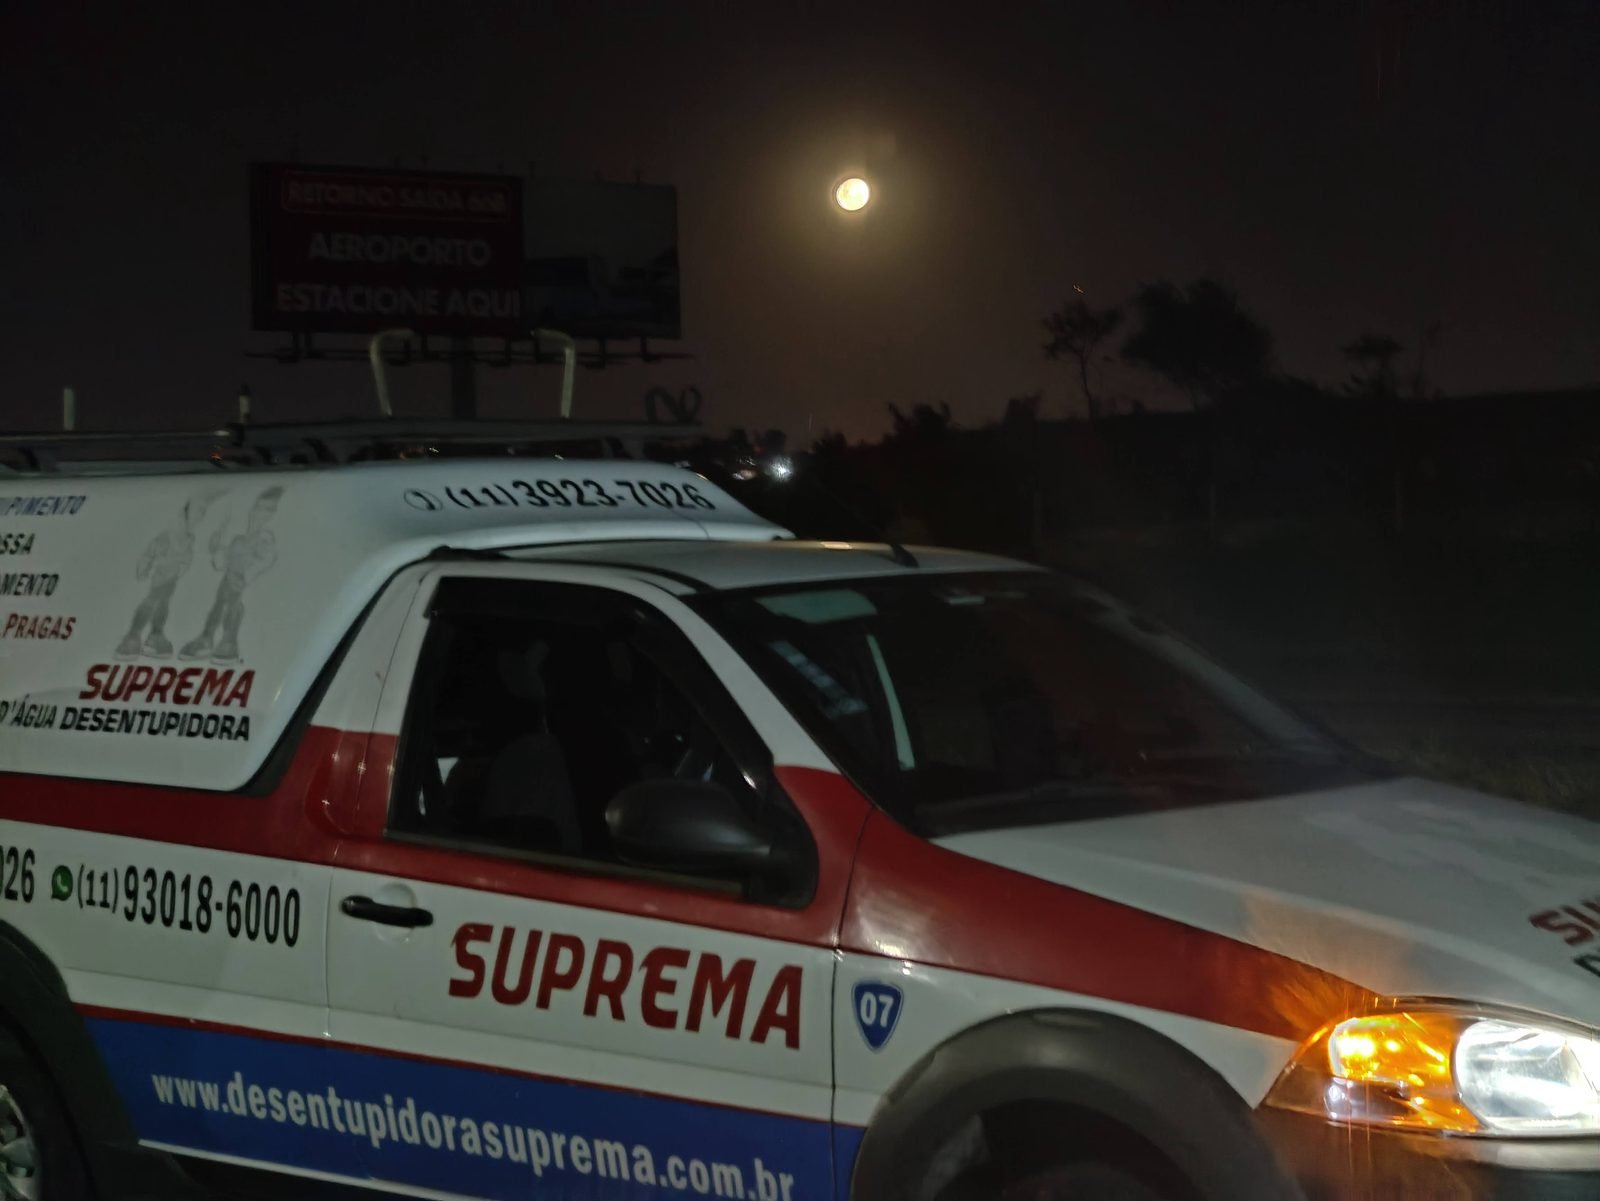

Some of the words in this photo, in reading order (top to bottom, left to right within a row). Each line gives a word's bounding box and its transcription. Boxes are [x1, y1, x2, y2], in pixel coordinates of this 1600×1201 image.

[308, 232, 491, 267] AEROPORTO
[276, 283, 440, 316] ESTACIONE
[446, 288, 520, 318] AQUI
[0, 533, 35, 555] SSA
[0, 573, 59, 597] MENTO
[3, 613, 76, 640] PRAGAS
[79, 664, 255, 708] SUPREMA
[59, 706, 250, 741] DESENTUPIDORA
[0, 845, 35, 903] 26
[449, 922, 804, 1050] SUPREMA
[860, 993, 896, 1028] 07
[151, 1071, 794, 1201] www.desentupidorasuprema.com.br
